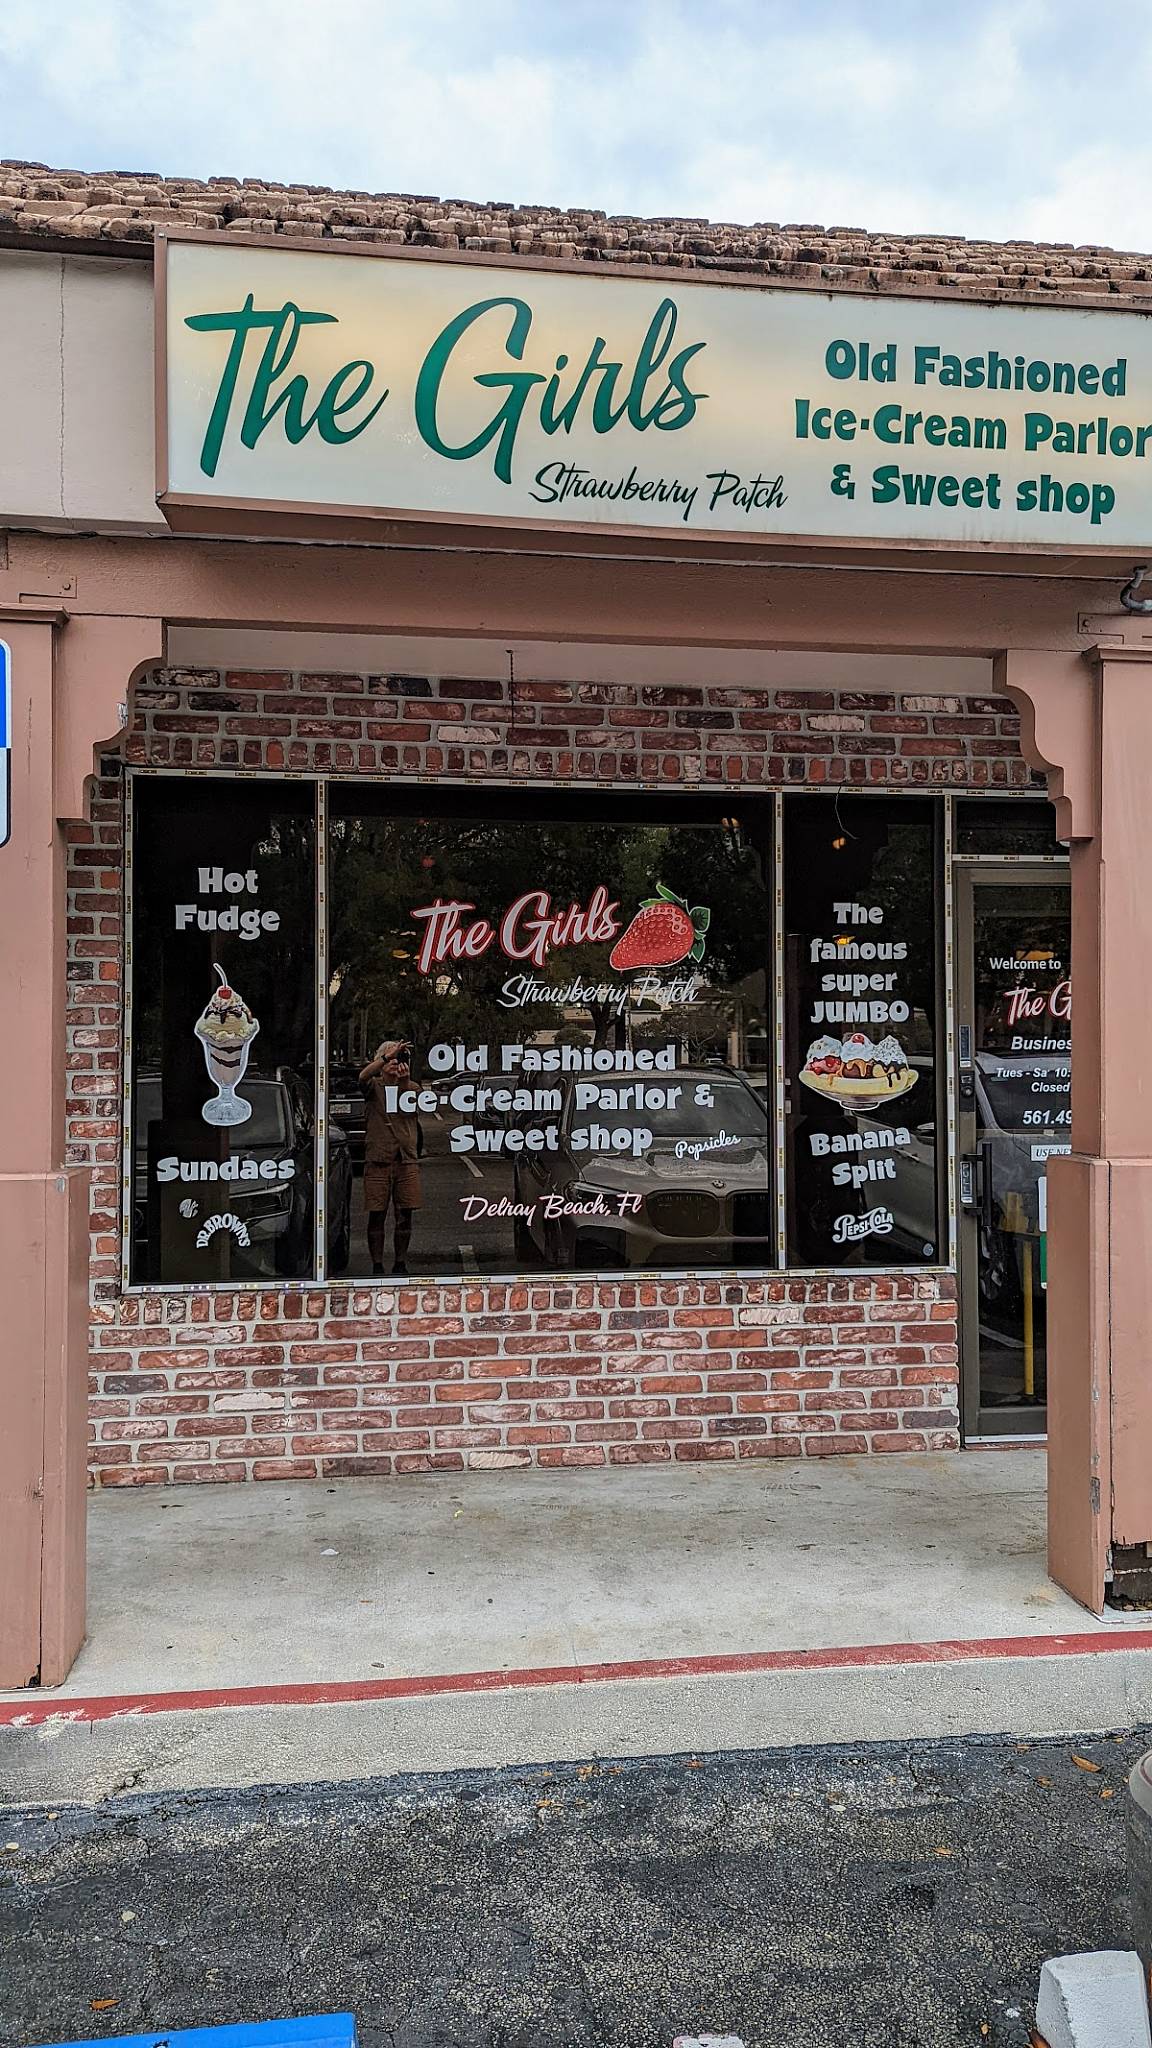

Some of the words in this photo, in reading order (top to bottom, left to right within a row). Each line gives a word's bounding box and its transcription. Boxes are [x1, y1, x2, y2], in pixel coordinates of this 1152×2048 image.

[825, 339, 897, 382] Old
[914, 346, 1127, 396] Fashioned
[184, 292, 388, 478] The
[415, 297, 709, 484] Girls
[1024, 412, 1152, 458] Parlor
[528, 461, 699, 521] Strawberry
[706, 469, 788, 513] Patch
[830, 464, 855, 499] &
[872, 465, 1000, 510] Sweet
[1016, 474, 1115, 525] shop
[198, 867, 258, 894] Hot
[175, 904, 281, 940] Fudge
[833, 902, 884, 924] The
[411, 898, 498, 975] The
[499, 884, 622, 968] Girls
[810, 938, 908, 962] famous
[989, 957, 1046, 970] Welcome
[1048, 959, 1061, 970] to
[496, 975, 629, 1016] Strawberry
[632, 974, 699, 1008] Patch
[821, 972, 898, 997] super
[811, 1001, 910, 1024] JUMBO
[1003, 985, 1046, 1026] The
[428, 1044, 489, 1072] Old
[501, 1044, 676, 1072] Fashioned
[996, 1067, 1023, 1078] Tues
[575, 1083, 682, 1111] Parlor
[693, 1084, 715, 1109] &
[1031, 1082, 1071, 1093] Closed
[450, 1124, 559, 1154] Sweet
[570, 1123, 653, 1156] shop
[674, 1130, 742, 1161] Popsicles
[809, 1127, 911, 1157] Banana
[156, 1156, 296, 1182] Sundaes
[832, 1158, 897, 1189] Split
[459, 1194, 538, 1226] Delray
[539, 1193, 611, 1220] Beach,
[616, 1191, 643, 1214] Fl
